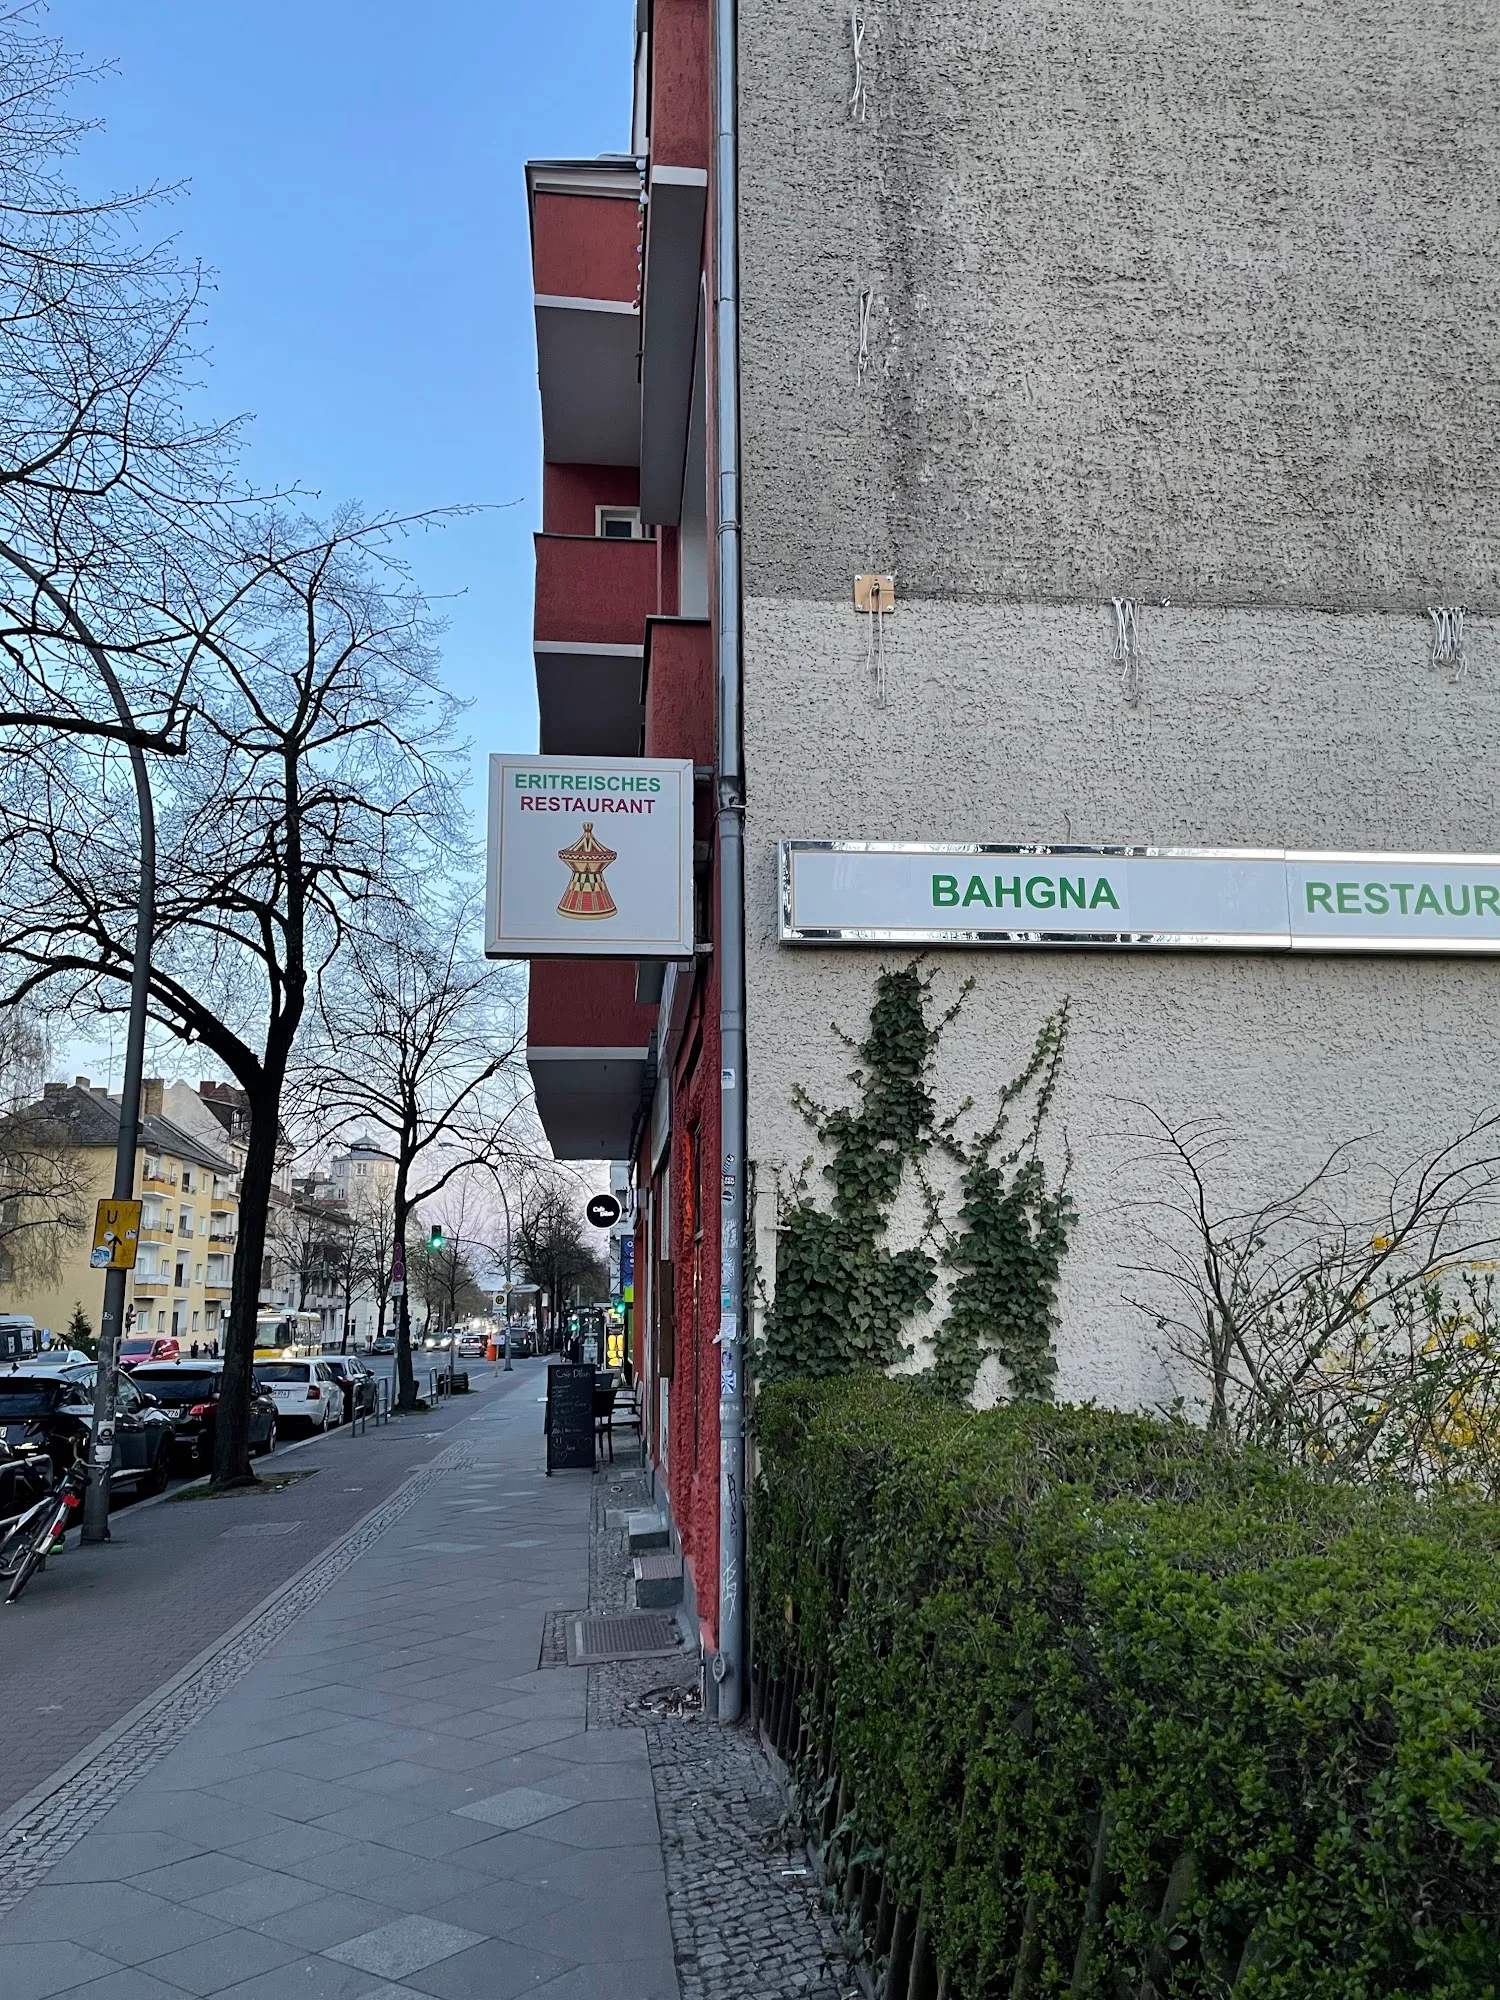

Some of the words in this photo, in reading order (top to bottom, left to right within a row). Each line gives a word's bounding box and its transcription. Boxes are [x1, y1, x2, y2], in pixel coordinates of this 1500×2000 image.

[515, 774, 661, 792] ERITREISCHES
[520, 796, 656, 814] RESTAURANT
[932, 875, 1120, 909] BAHGNA
[1305, 881, 1500, 916] RESTAUR
[107, 1209, 118, 1224] U
[43, 1329, 49, 1337] P
